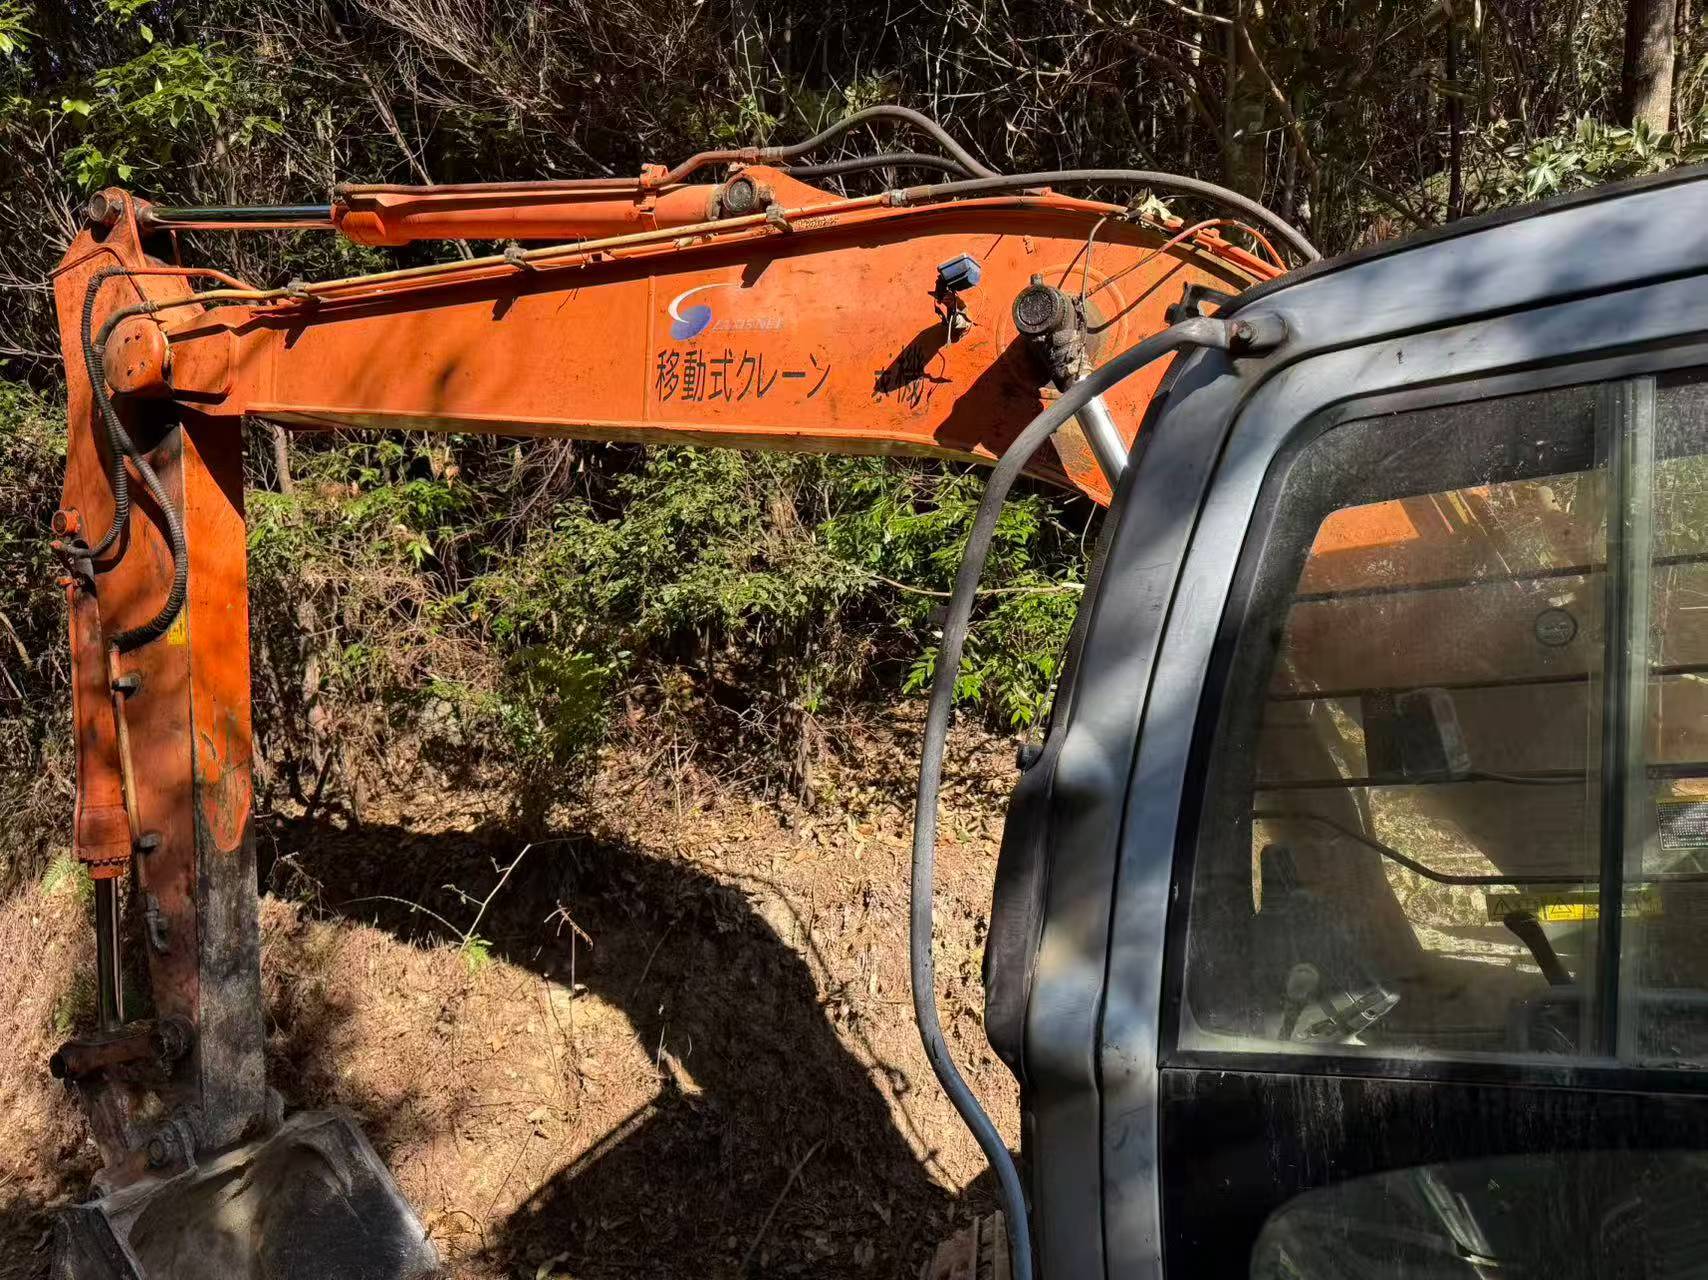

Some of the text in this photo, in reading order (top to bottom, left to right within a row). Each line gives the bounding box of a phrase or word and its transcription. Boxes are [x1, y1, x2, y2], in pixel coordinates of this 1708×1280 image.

[655, 348, 831, 401] 移動式クレーン
